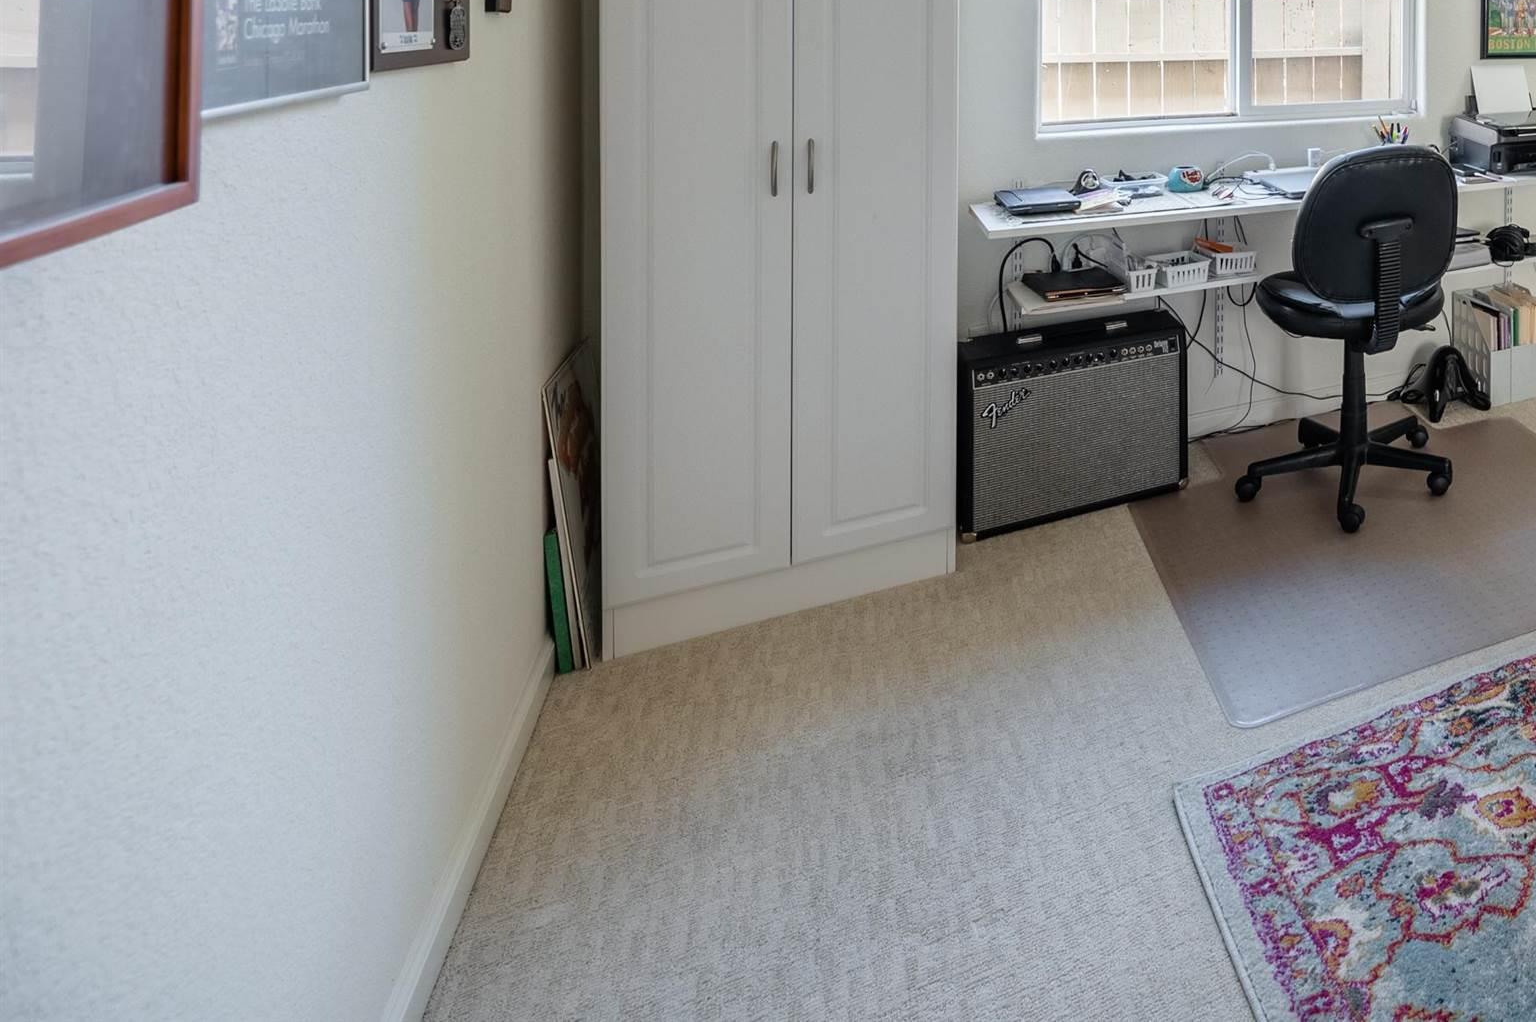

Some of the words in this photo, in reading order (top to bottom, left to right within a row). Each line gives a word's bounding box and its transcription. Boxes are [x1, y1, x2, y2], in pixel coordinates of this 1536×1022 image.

[244, 17, 286, 44] Chicago
[288, 13, 330, 37] Marathon
[1488, 38, 1531, 51] BOSTON
[980, 386, 1031, 429] Fender
